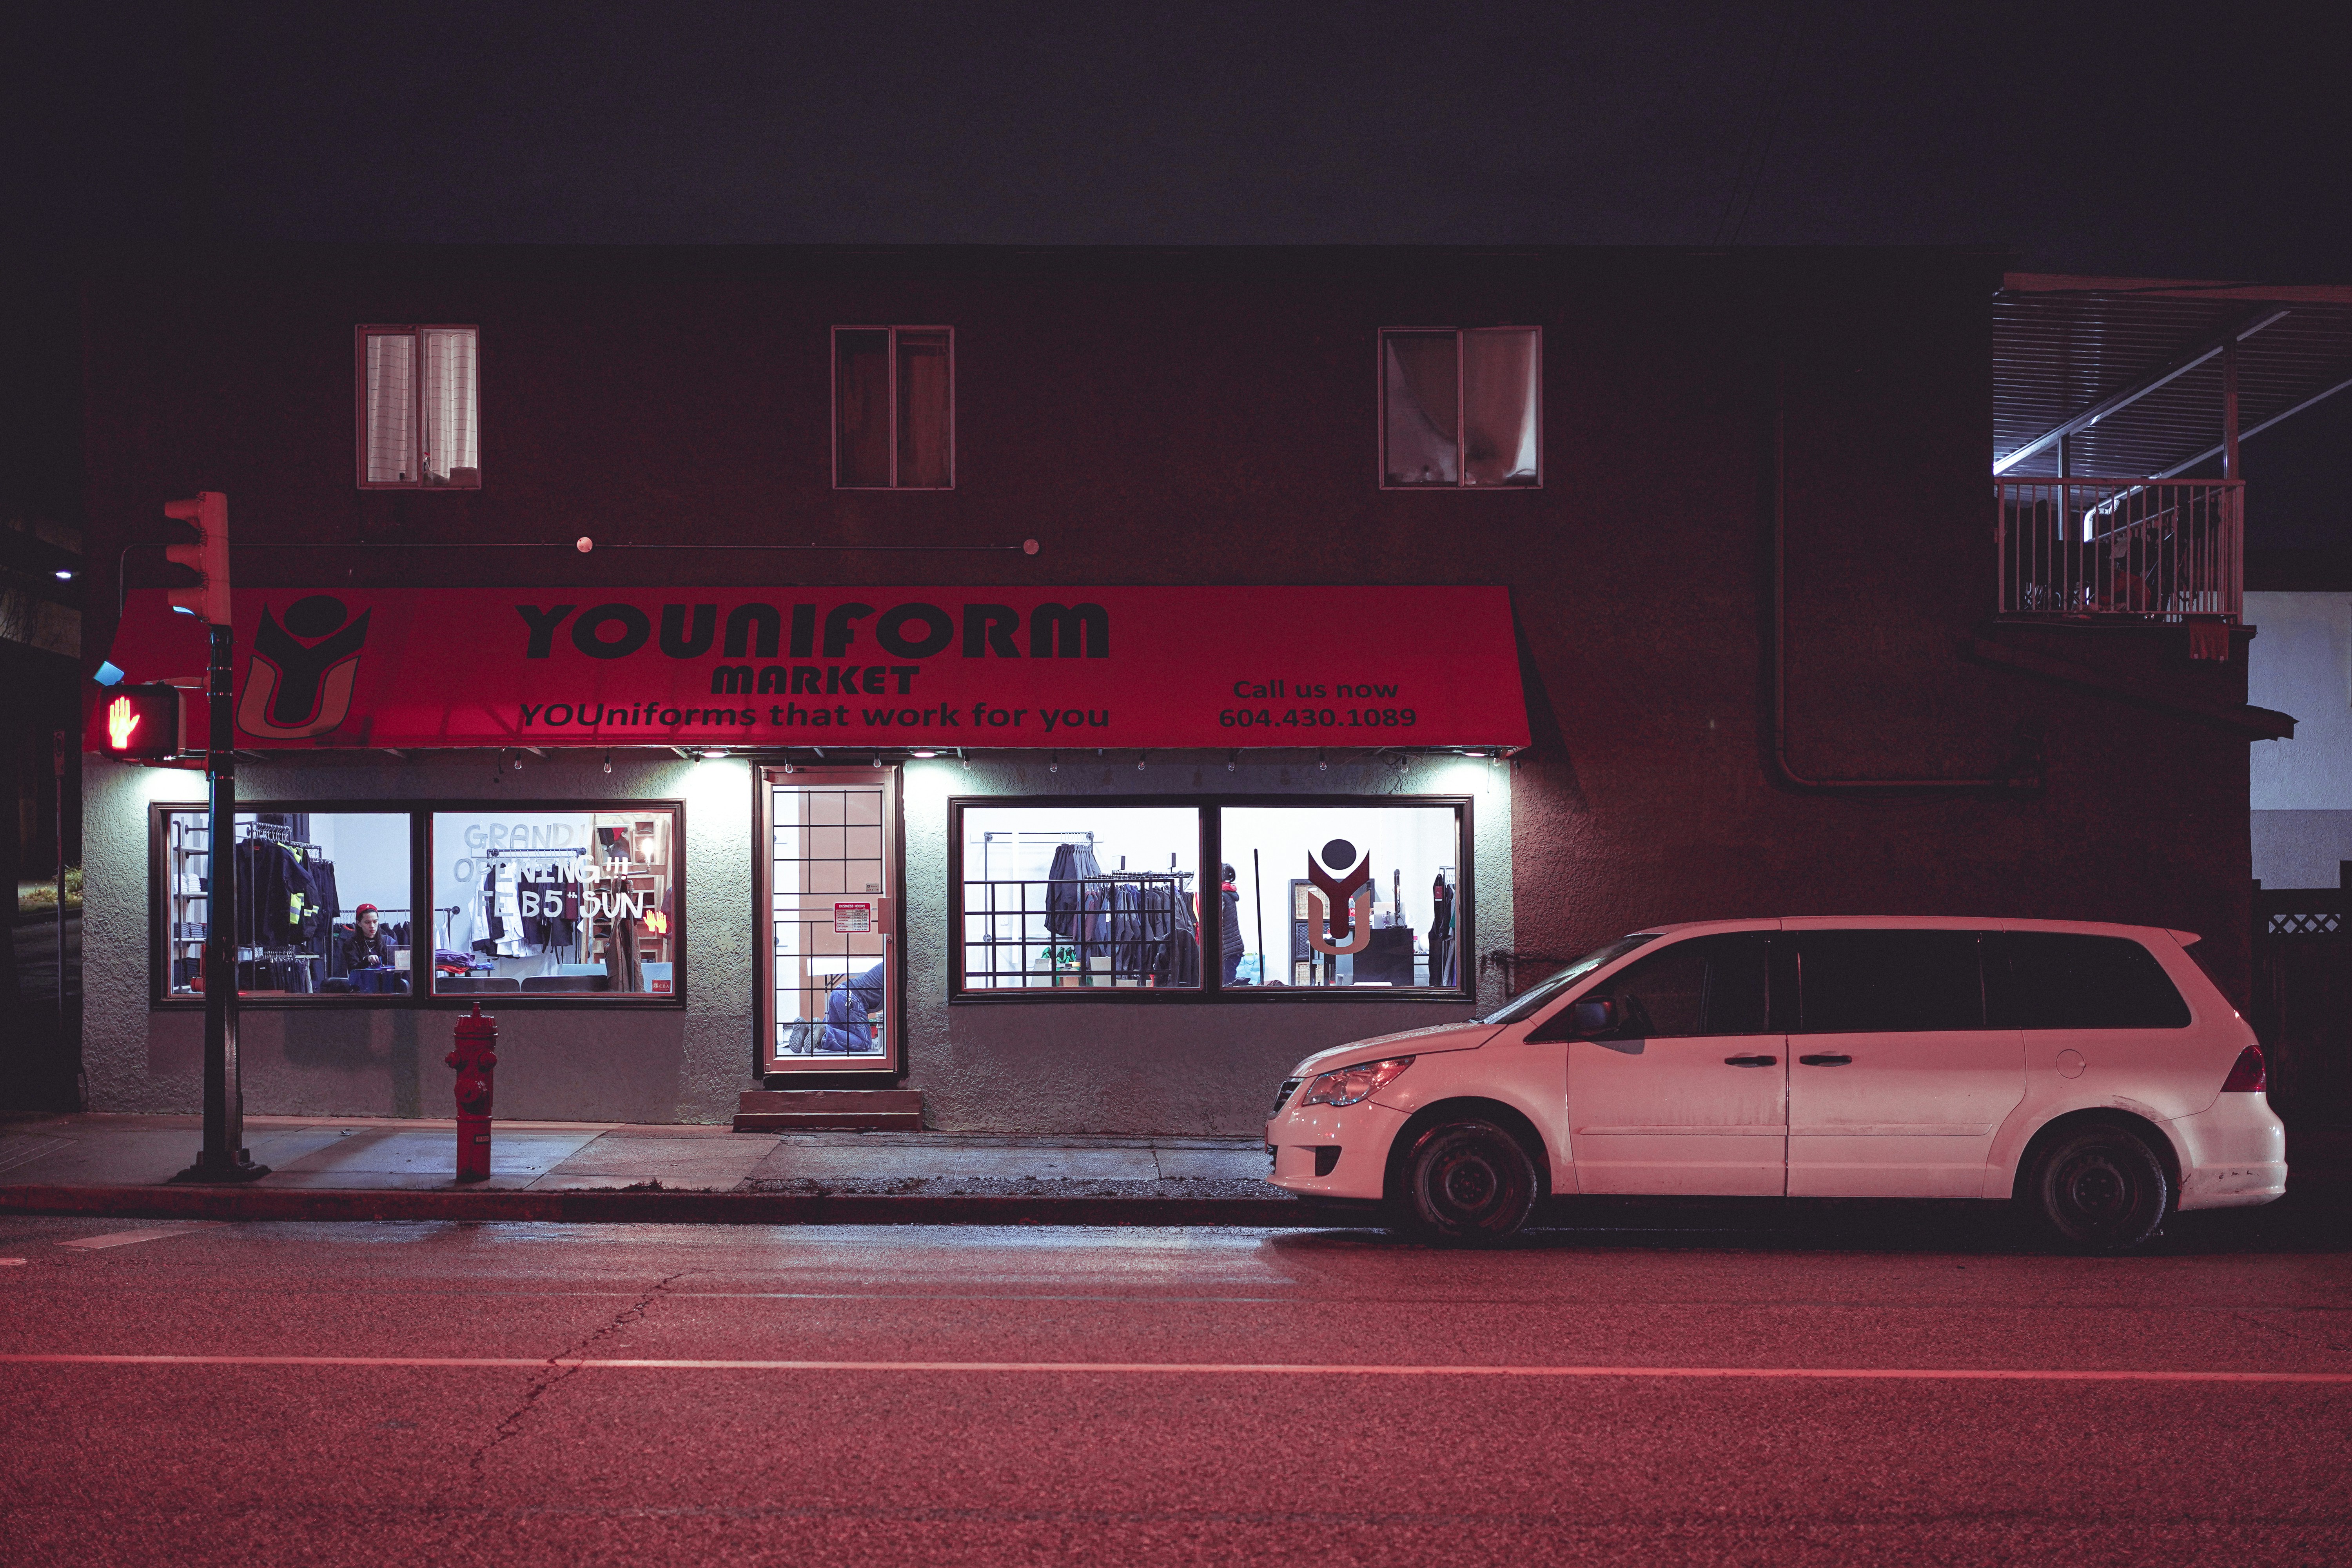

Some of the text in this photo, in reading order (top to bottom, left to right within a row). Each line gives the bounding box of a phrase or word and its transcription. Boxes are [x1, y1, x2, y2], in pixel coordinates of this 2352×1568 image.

[515, 603, 1109, 659] YOUNIFORM
[711, 665, 920, 694] MARKET
[1233, 680, 1398, 698] Call us now
[520, 702, 1109, 732] YOUniforms that work for you
[1220, 709, 1416, 727] 604.430.1089
[580, 891, 643, 918] SUN
